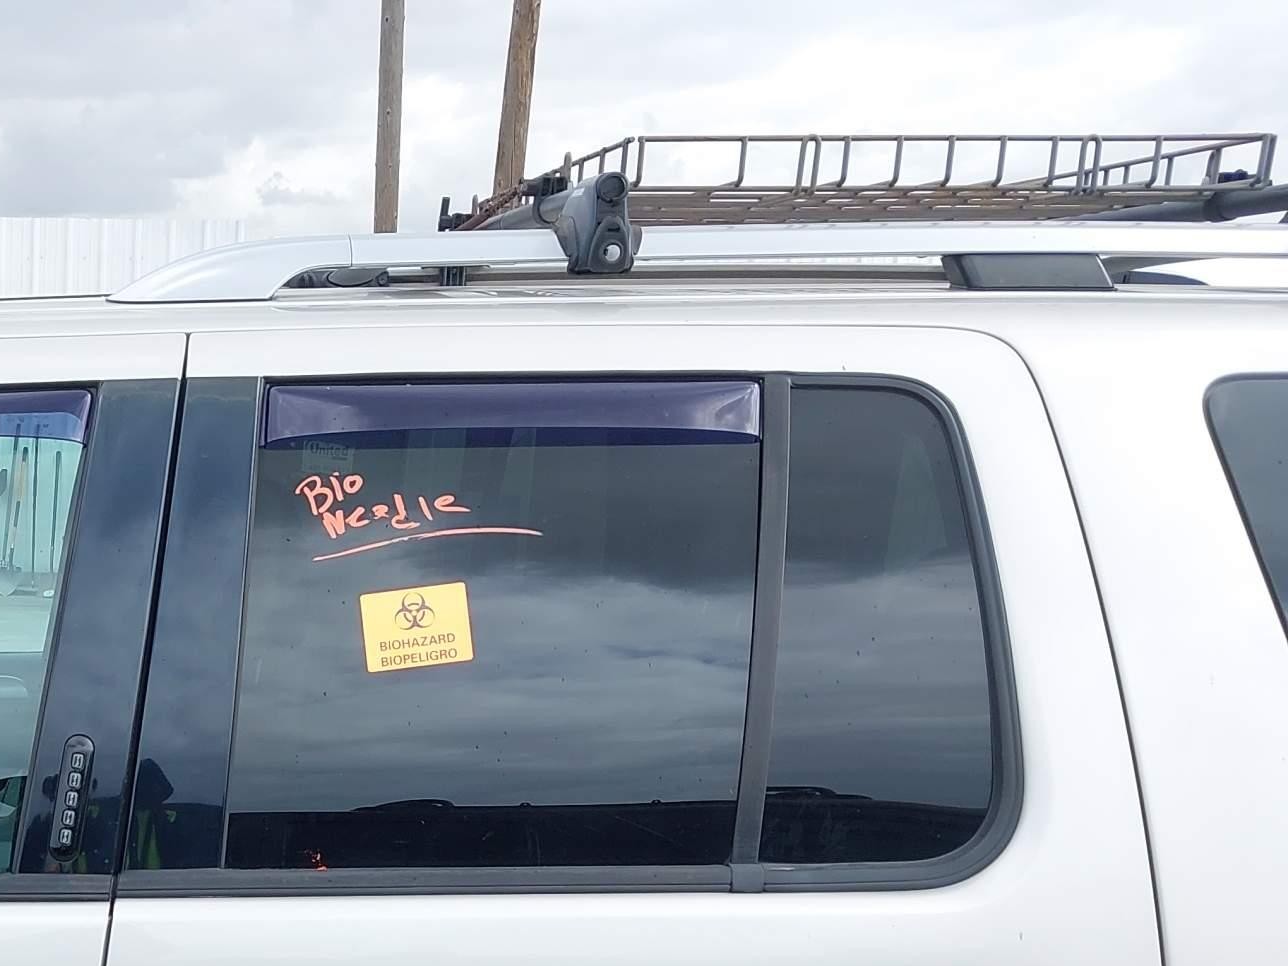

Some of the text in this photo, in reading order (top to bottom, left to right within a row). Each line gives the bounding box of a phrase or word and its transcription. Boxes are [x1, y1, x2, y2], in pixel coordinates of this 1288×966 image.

[294, 472, 364, 517] Bio
[379, 632, 456, 652] BIOHAZARD
[380, 647, 459, 667] BIOPELIGRO
